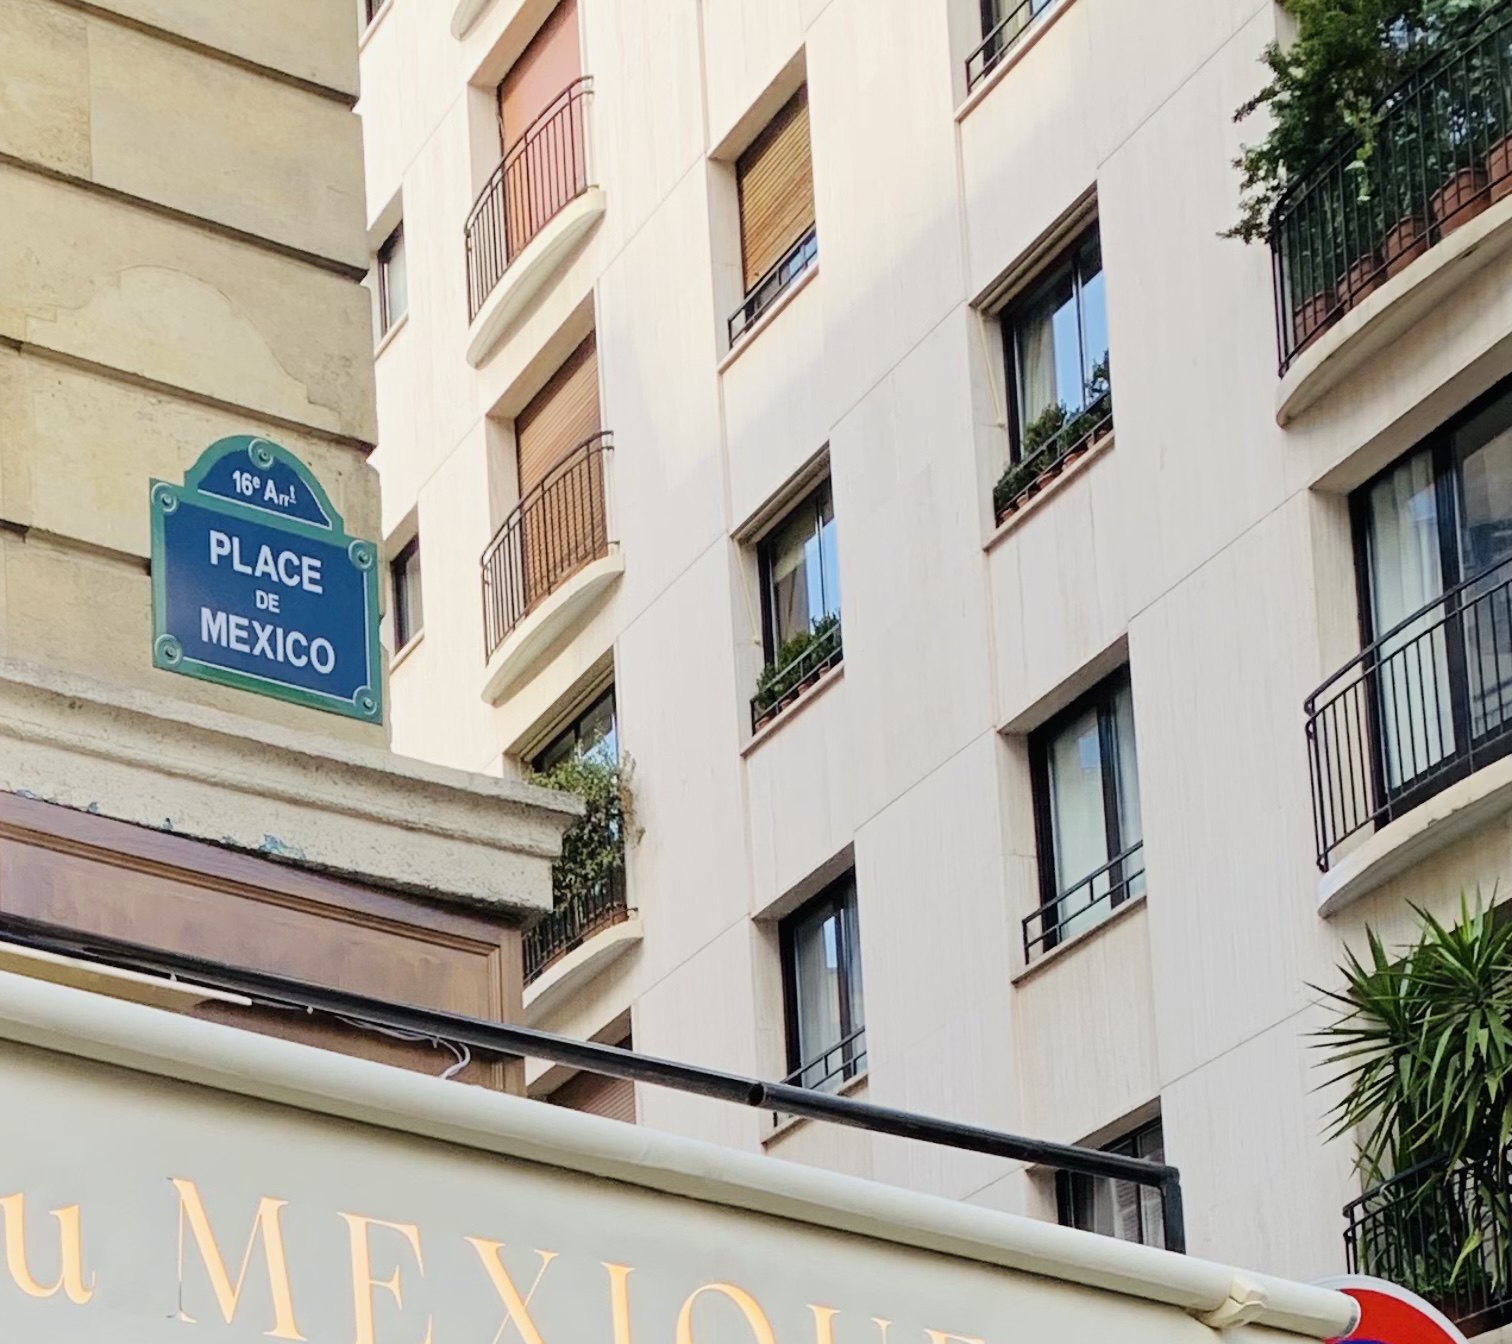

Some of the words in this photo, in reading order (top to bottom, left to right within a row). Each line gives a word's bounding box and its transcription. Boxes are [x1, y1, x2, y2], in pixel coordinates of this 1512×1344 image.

[232, 470, 260, 497] 16e
[209, 529, 323, 594] PLACE
[255, 589, 280, 614] DE
[200, 607, 336, 675] MEXICO
